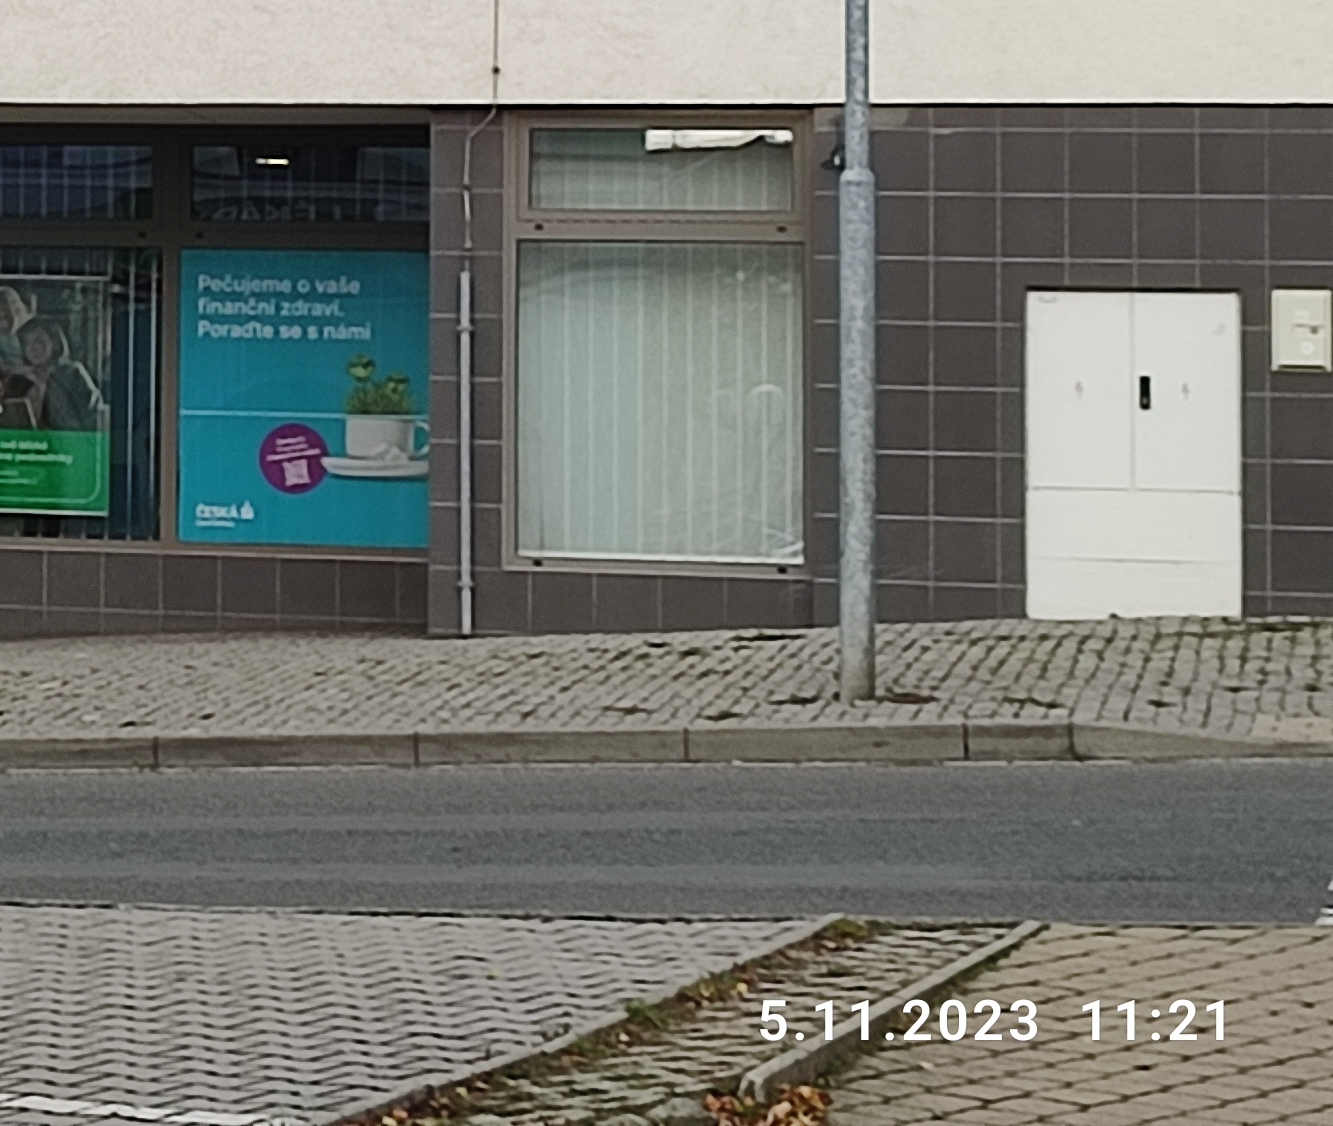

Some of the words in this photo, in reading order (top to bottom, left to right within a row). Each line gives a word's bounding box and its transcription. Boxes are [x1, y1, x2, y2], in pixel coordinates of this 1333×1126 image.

[197, 274, 292, 296] Pečujeme
[296, 278, 311, 294] o
[315, 275, 361, 295] vaše
[197, 297, 276, 315] finanční
[197, 319, 274, 340] Poraďte
[278, 325, 302, 340] se
[306, 325, 319, 340] s
[323, 323, 372, 341] námi
